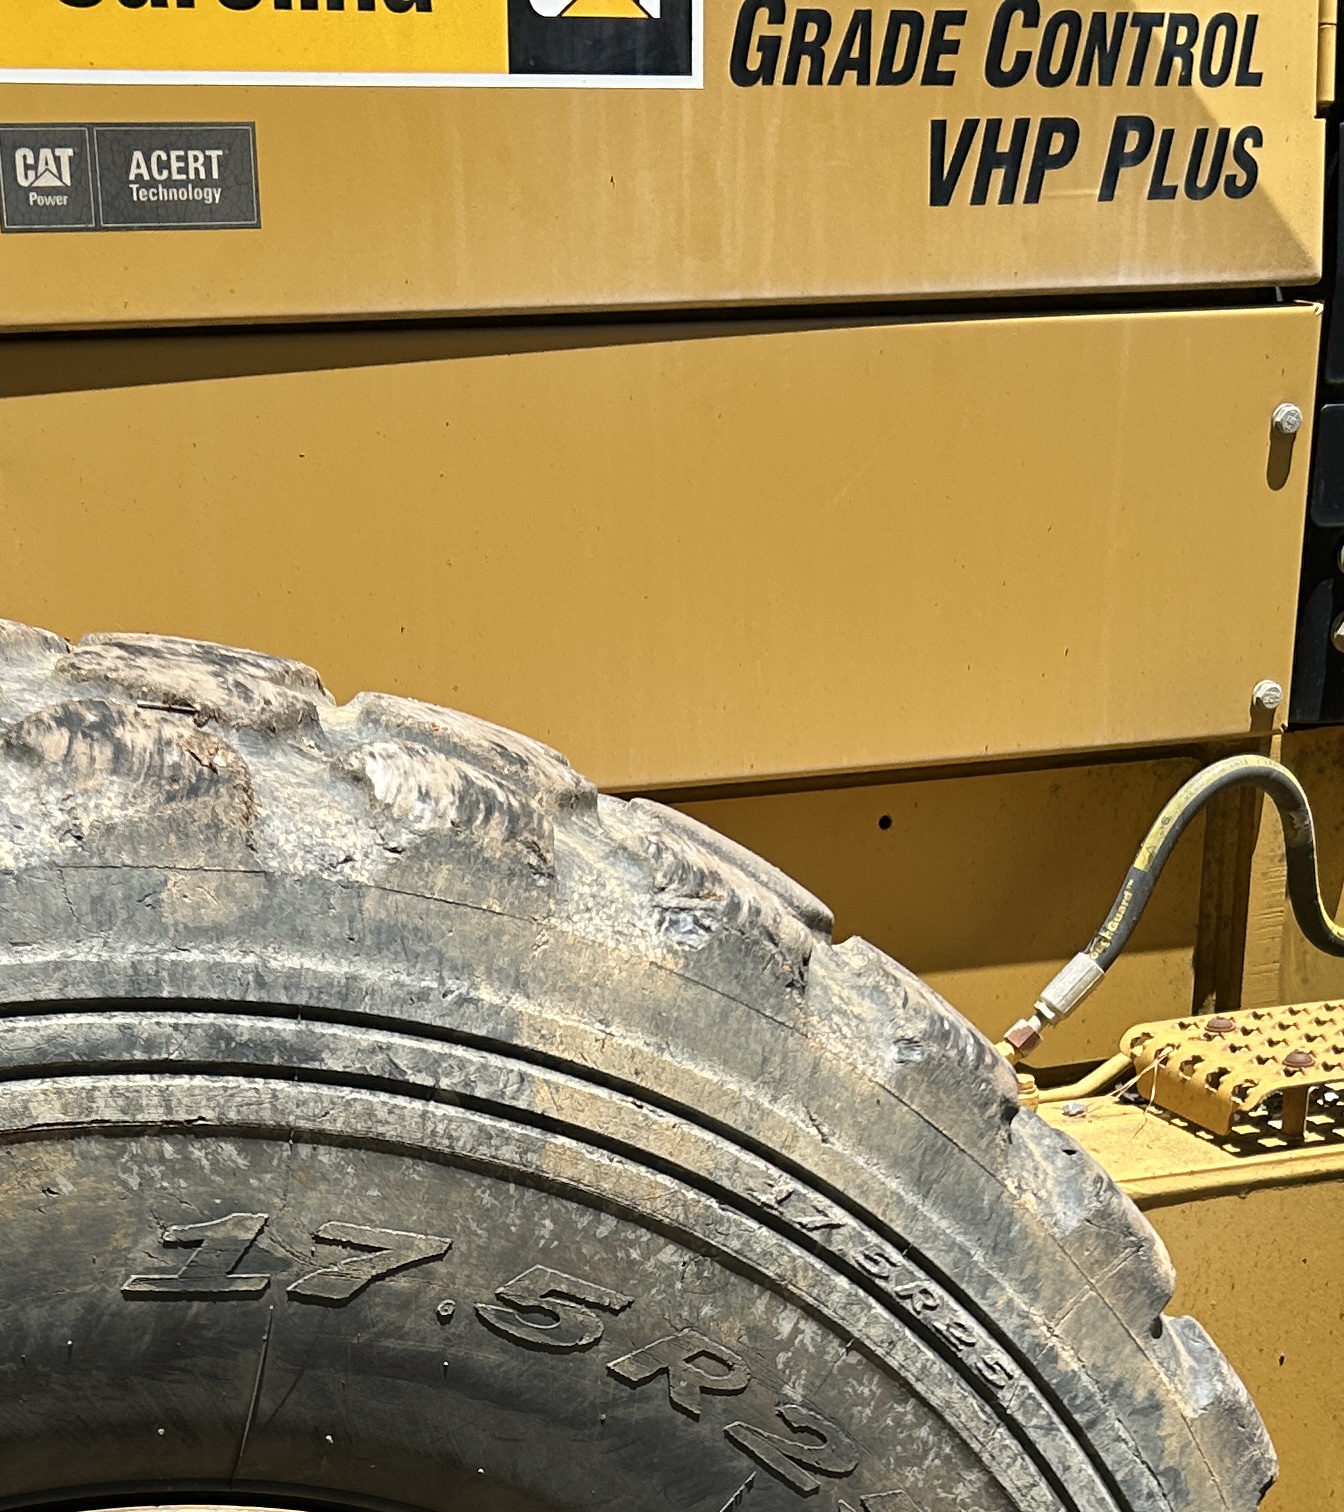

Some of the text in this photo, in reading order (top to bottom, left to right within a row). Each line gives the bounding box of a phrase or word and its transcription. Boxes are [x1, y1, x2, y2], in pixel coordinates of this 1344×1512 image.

[728, 0, 1264, 88] GRADE CONTROL
[14, 147, 74, 188] CAT
[128, 150, 224, 181] ACERT
[929, 115, 1264, 207] VHP PLUS
[29, 192, 69, 206] Power
[128, 183, 222, 204] Technology
